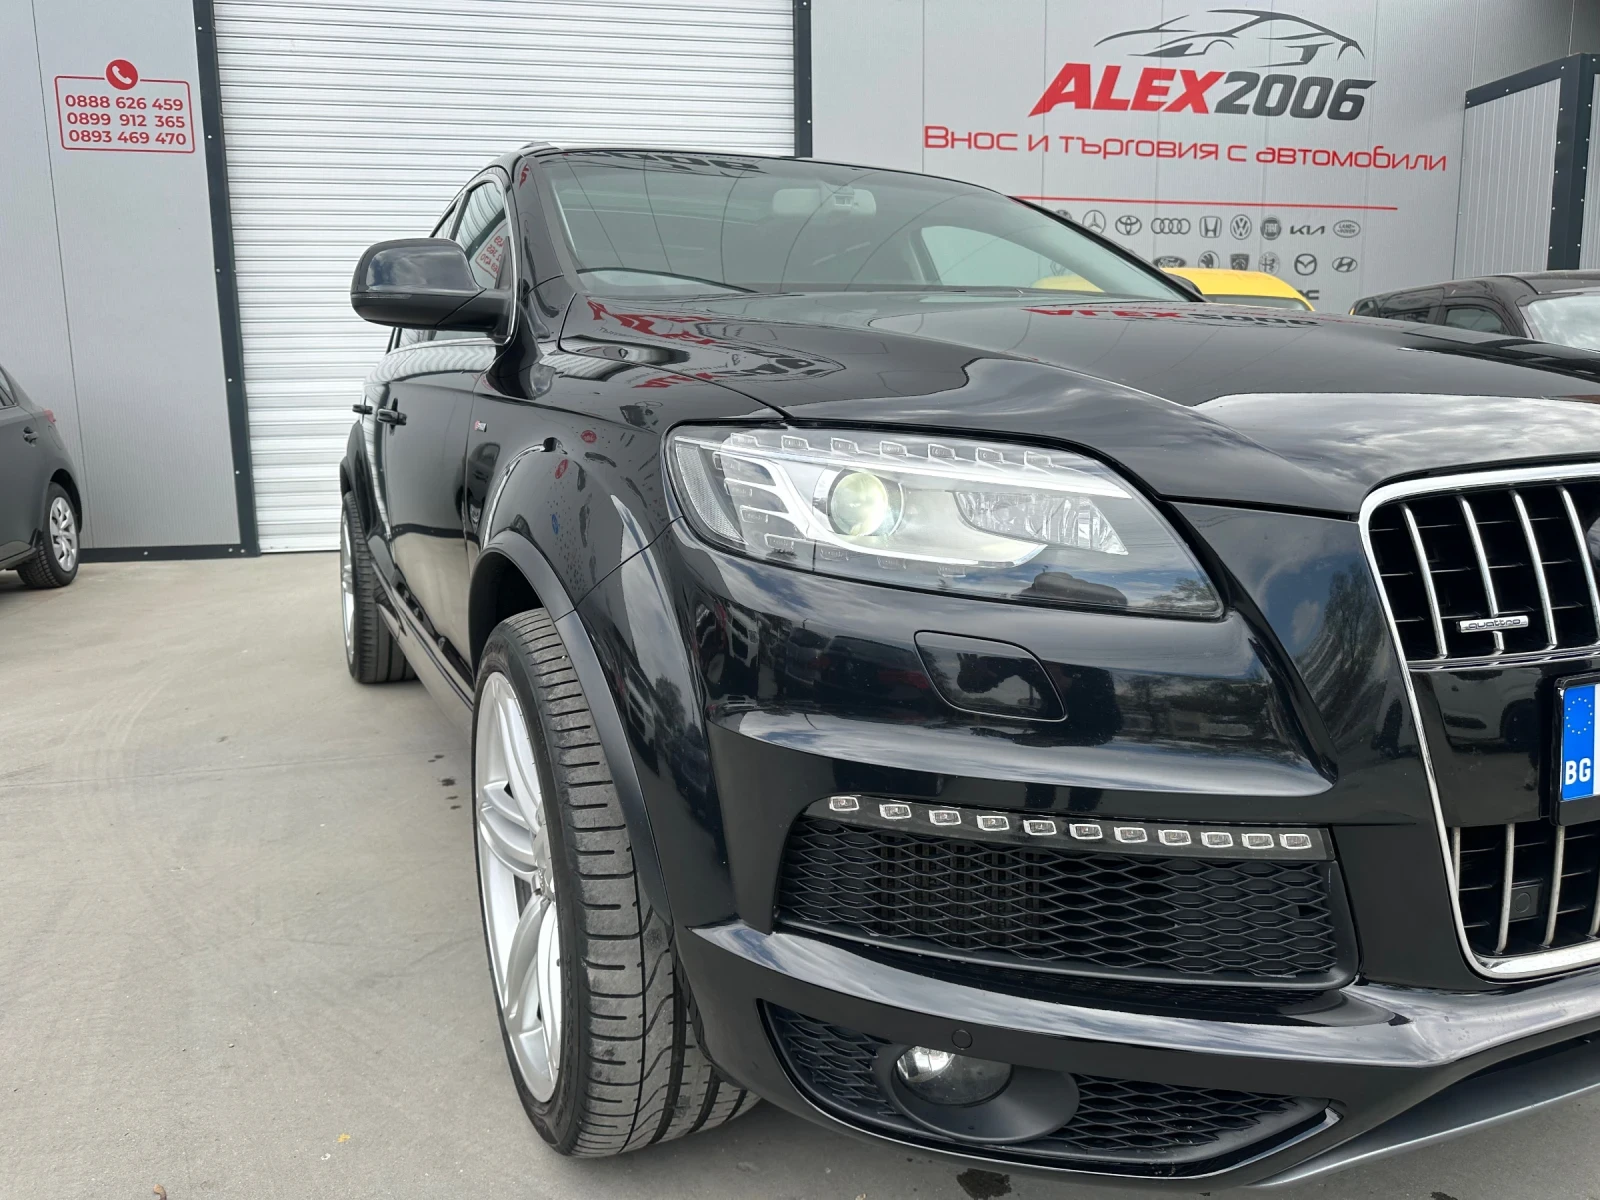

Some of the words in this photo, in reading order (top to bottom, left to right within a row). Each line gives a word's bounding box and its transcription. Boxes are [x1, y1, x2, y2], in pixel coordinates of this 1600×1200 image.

[1027, 62, 1377, 121] ALEX2006
[65, 94, 111, 109] 0888
[115, 96, 147, 110] 626
[152, 98, 183, 111] 459
[67, 112, 111, 126] 0899
[119, 114, 147, 127] 912
[154, 115, 185, 128] 365
[68, 129, 112, 143] 0893
[117, 131, 150, 144] 469
[155, 132, 187, 145] 470
[924, 125, 1018, 151] Внос
[1027, 134, 1049, 153] и
[1058, 135, 1219, 160] търговия
[1255, 145, 1447, 172] автомобили
[1468, 618, 1521, 630] quattro
[1565, 757, 1591, 785] BG
